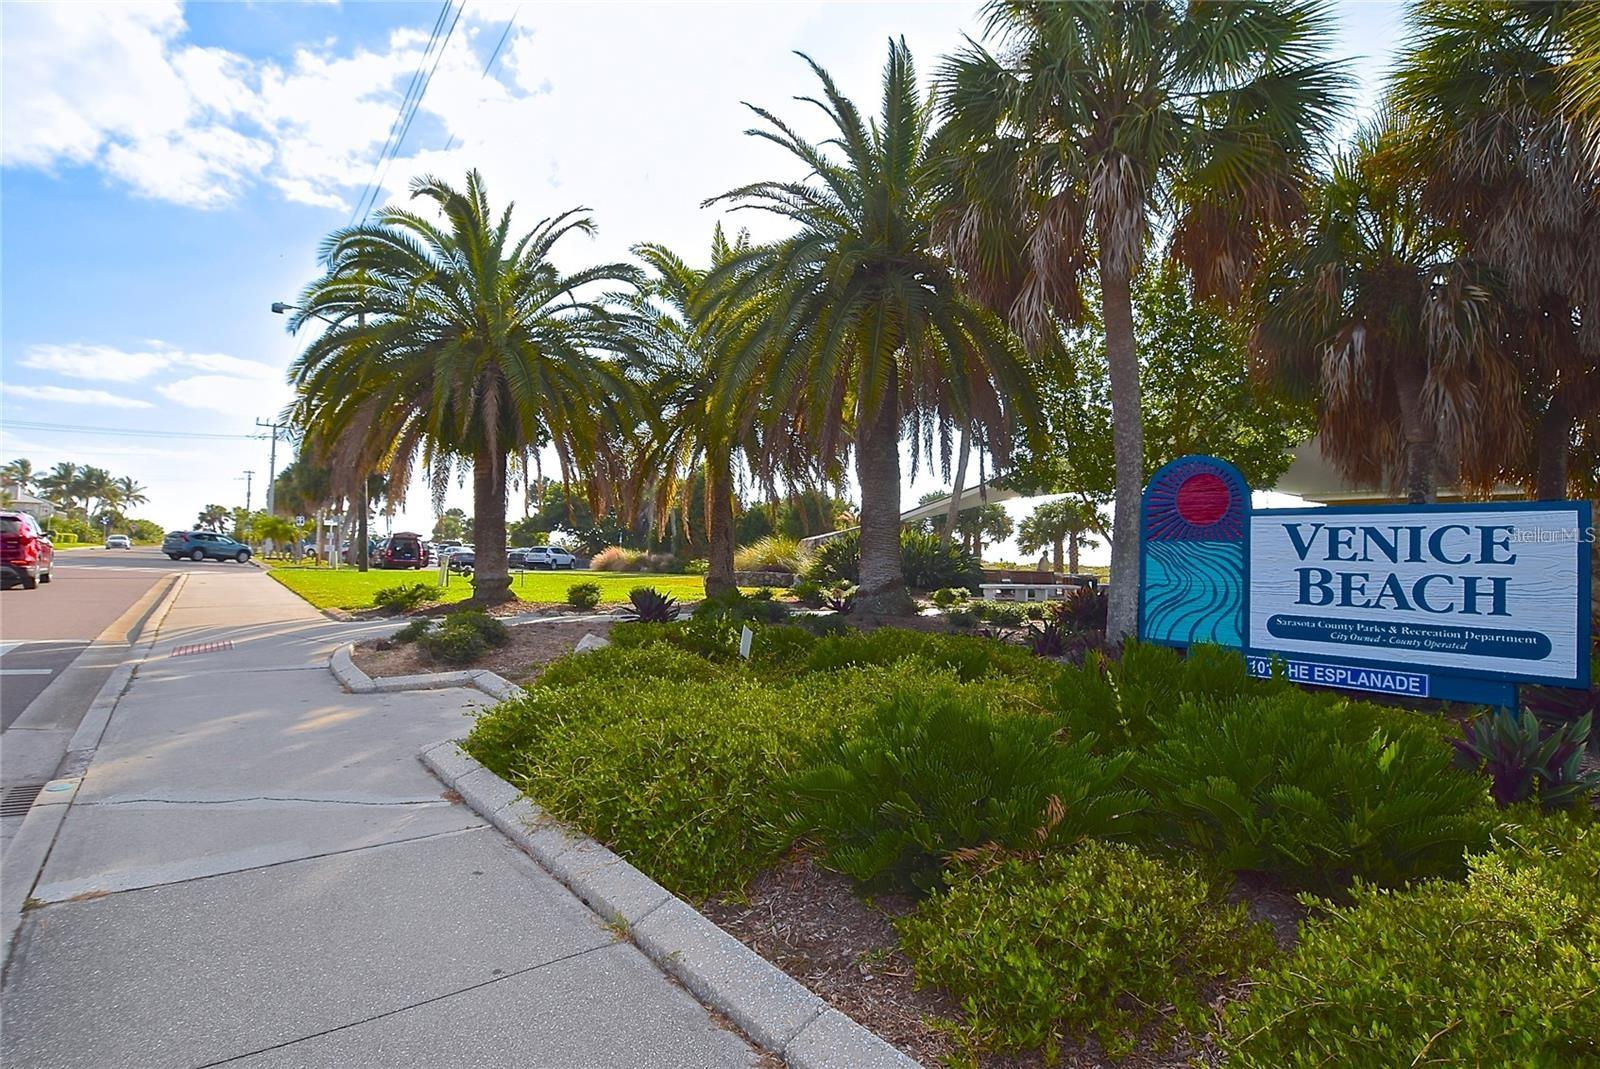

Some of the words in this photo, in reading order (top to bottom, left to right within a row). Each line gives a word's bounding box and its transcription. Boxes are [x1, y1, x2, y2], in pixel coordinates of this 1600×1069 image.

[1281, 523, 1517, 565] VENICE
[1294, 567, 1513, 617] BEACH
[1276, 618, 1316, 628] Sarasota
[1318, 620, 1354, 633] County
[1357, 623, 1386, 633] Parks
[1388, 626, 1398, 634] &
[1401, 626, 1461, 639] Recreation
[1465, 631, 1538, 645] Department
[1330, 631, 1349, 642] City
[1350, 633, 1381, 643] Owned
[1389, 636, 1422, 647] County
[1424, 638, 1468, 650] Operated
[1280, 662, 1309, 679] HE
[1314, 667, 1420, 692] ESPLANADE
